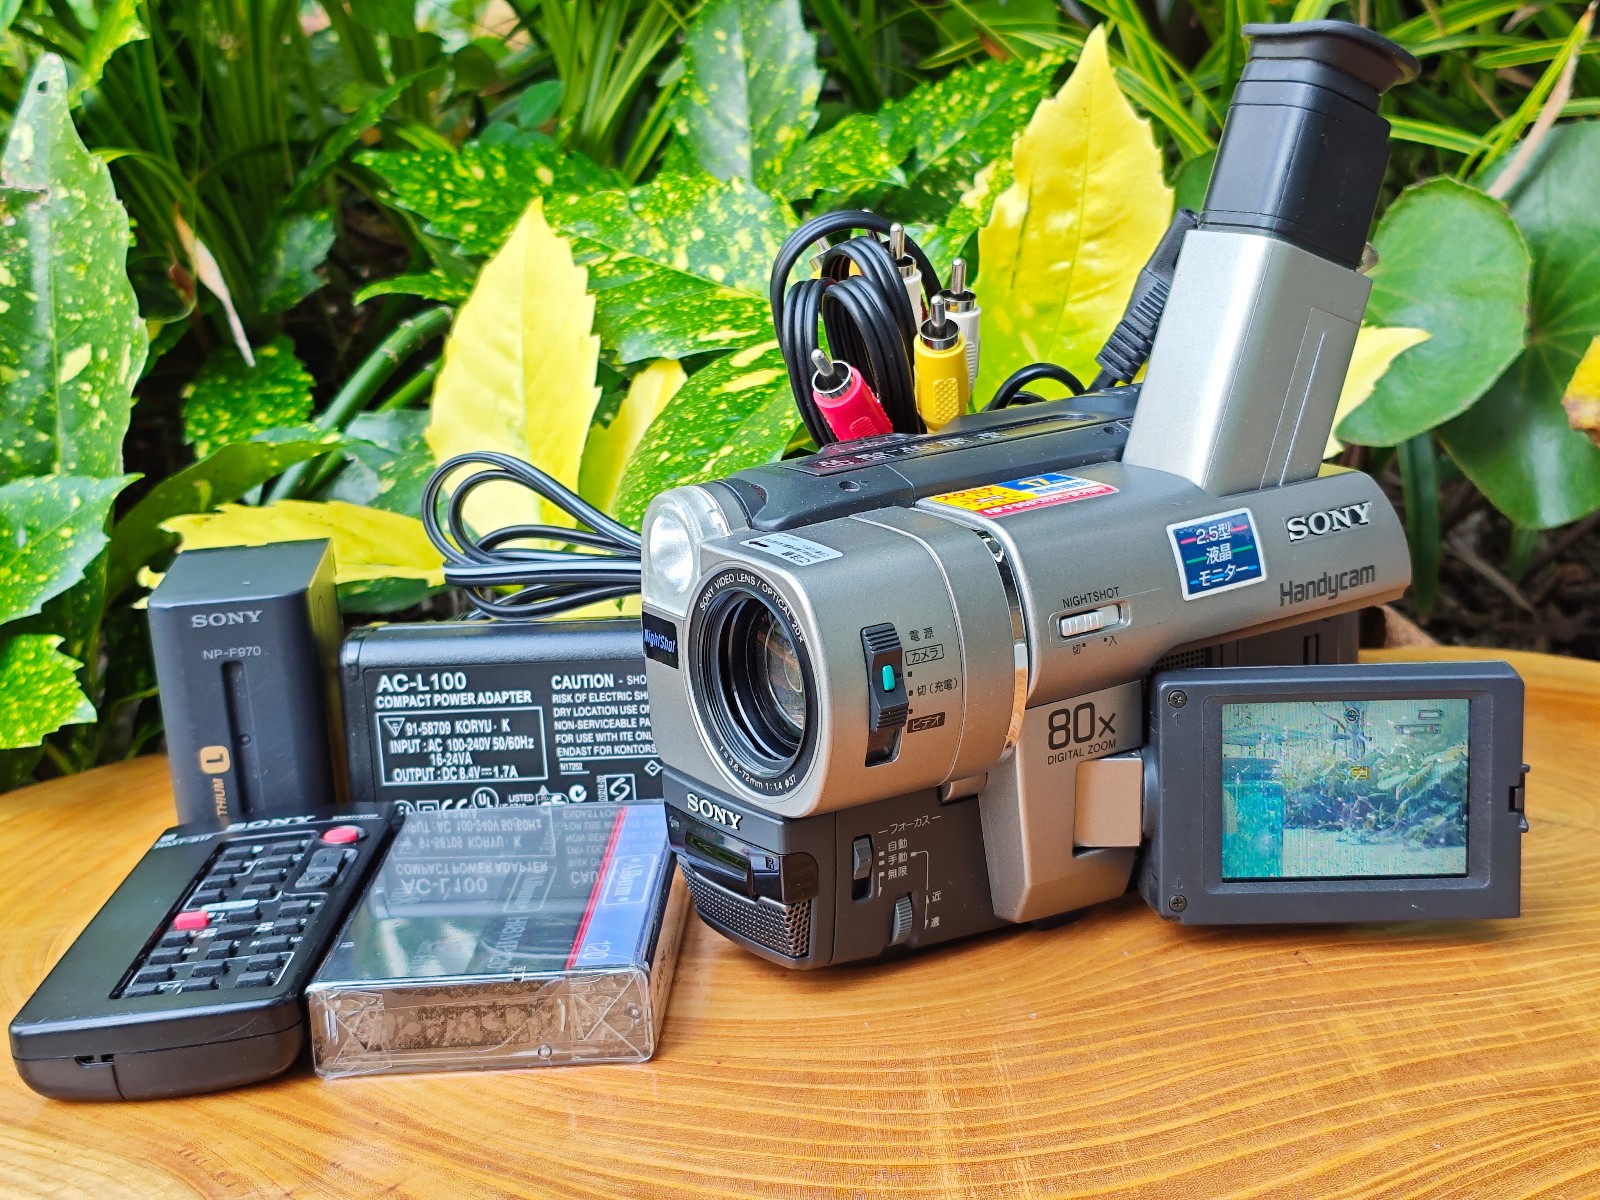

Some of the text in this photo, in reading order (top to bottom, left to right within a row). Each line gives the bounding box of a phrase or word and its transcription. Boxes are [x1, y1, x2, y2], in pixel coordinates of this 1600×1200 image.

[1287, 501, 1372, 542] SONY
[1196, 522, 1231, 545] 2.5型
[1206, 543, 1232, 565] 液晶
[1199, 564, 1248, 587] モニター
[1280, 564, 1376, 607] Handycam
[699, 586, 715, 611] SONY
[714, 573, 735, 589] VIDEO
[736, 573, 756, 586] LENS
[761, 583, 792, 621] OPTICAL
[1062, 587, 1120, 608] NIGHTSHOT
[191, 610, 263, 628] SONY
[644, 628, 676, 653] NightShot
[909, 626, 935, 641] 電源
[1108, 636, 1118, 646] 入
[203, 646, 261, 660] NP-F970
[912, 647, 939, 663] カメラ
[376, 672, 467, 693] AC-L100
[551, 674, 614, 690] CAUTION
[376, 690, 532, 709] COMPACT POWER ADAPTER
[552, 693, 573, 704] RISK
[574, 692, 588, 703] OF
[588, 691, 633, 703] ELECTRIC
[553, 706, 572, 718] DRY
[573, 705, 618, 717] LOCATION
[621, 704, 638, 715] USE
[406, 721, 451, 736] 91-58709
[501, 718, 511, 732] K
[554, 718, 637, 730] NON-SERVICEABLE
[912, 715, 941, 730] ビデオ
[428, 738, 443, 752] AC
[446, 737, 491, 752] 100-240V
[492, 736, 535, 751] 50/60Hz
[555, 733, 574, 744] FOR
[576, 732, 594, 743] USE
[594, 732, 618, 742] WITH
[619, 731, 634, 741] ITE
[429, 752, 473, 767] 16-24VA
[556, 746, 593, 757] ENDAST
[593, 746, 612, 755] FOR
[1047, 739, 1116, 765] DIGITAL ZOOM
[442, 767, 458, 781] DC
[459, 766, 481, 780] 8.4V
[493, 765, 519, 779] 1.7A
[508, 794, 534, 803] LISTED
[686, 793, 743, 831] SONY
[226, 815, 316, 832] SONY
[890, 815, 931, 835] フォーカス
[888, 838, 908, 852] 自動
[888, 852, 908, 865] 手動
[888, 866, 908, 880] 無限
[932, 891, 942, 902] 近
[582, 940, 612, 960] 120
